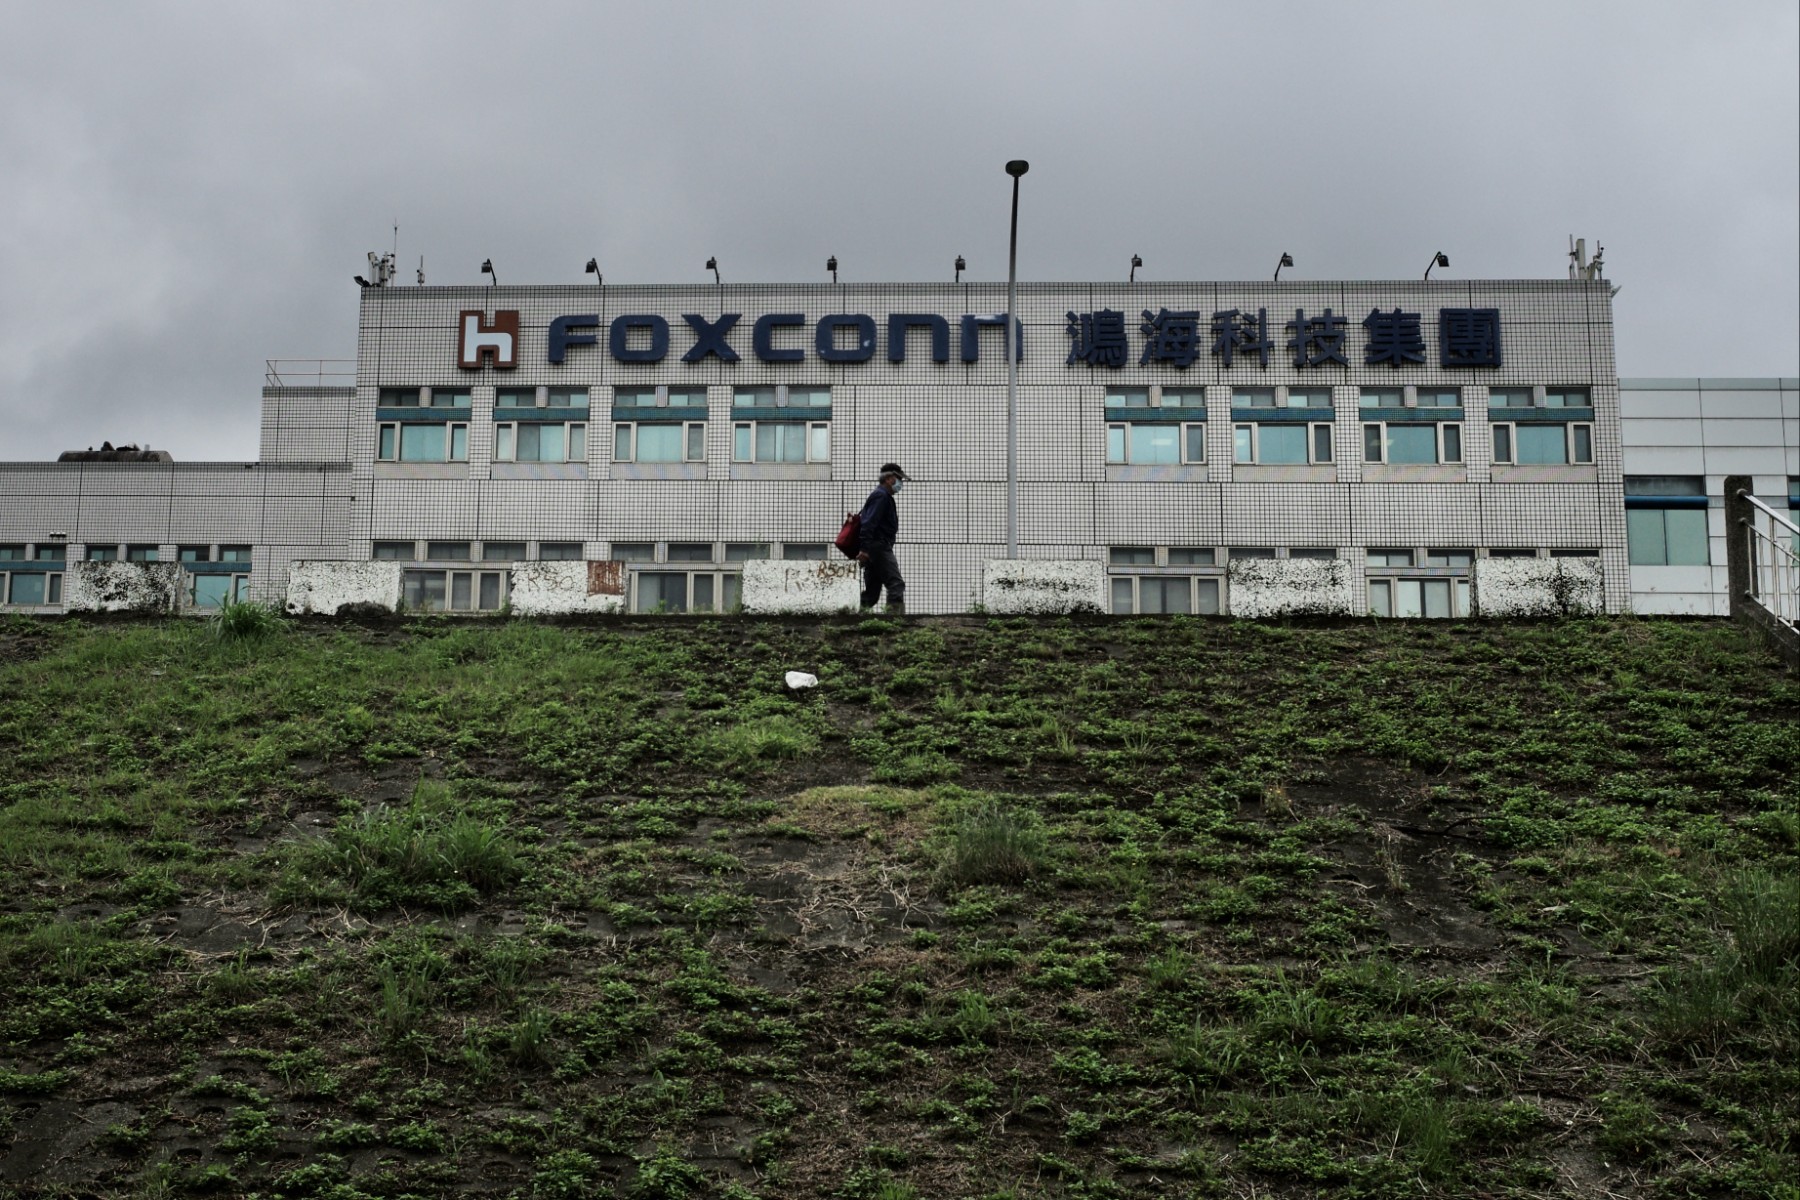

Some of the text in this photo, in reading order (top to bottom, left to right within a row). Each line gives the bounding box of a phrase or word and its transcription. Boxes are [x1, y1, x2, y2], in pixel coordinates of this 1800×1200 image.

[1065, 307, 1501, 369] 鴻海科技集團
